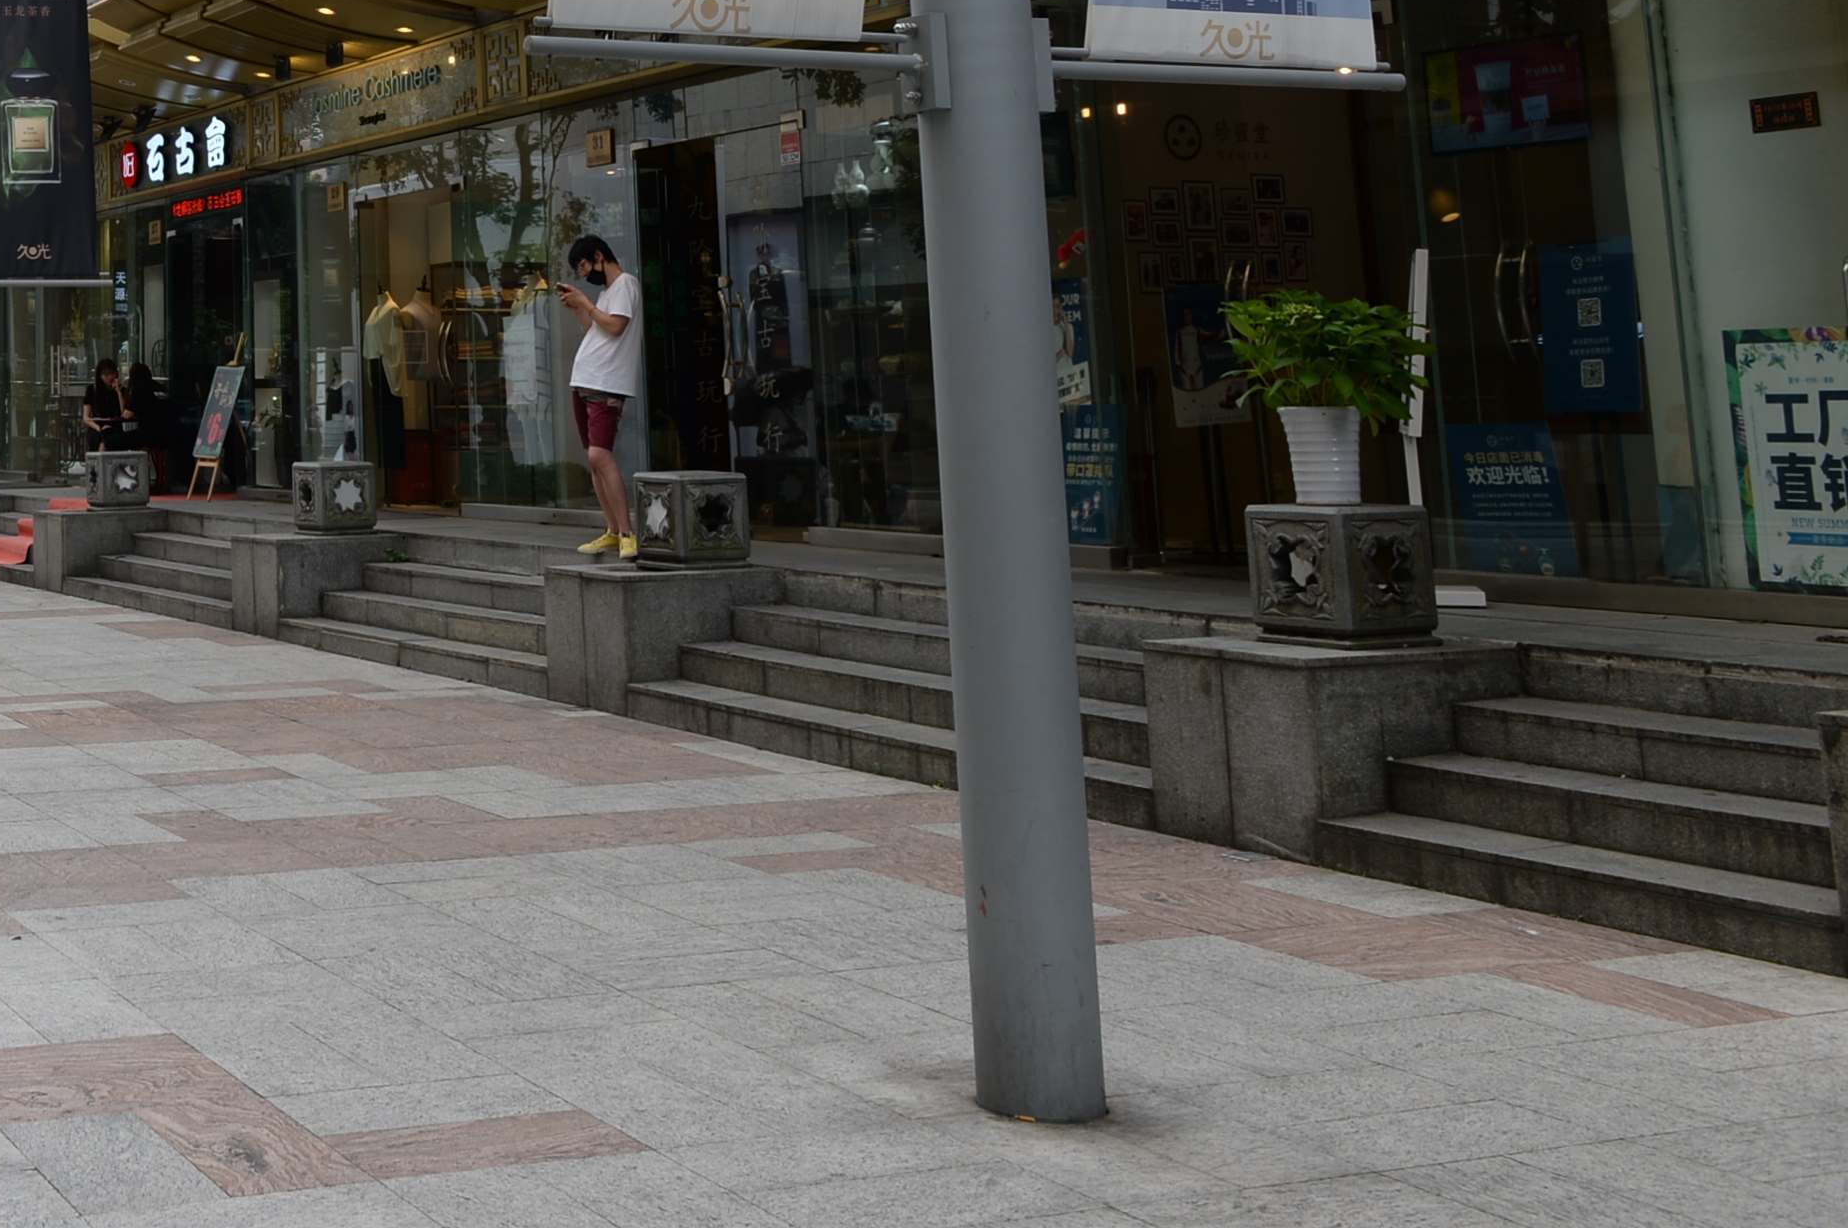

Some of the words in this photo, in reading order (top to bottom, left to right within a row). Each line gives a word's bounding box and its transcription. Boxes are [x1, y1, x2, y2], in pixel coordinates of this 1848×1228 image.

[1200, 19, 1276, 61] 久光
[363, 65, 442, 101] Cashmere
[16, 243, 52, 260] 久光
